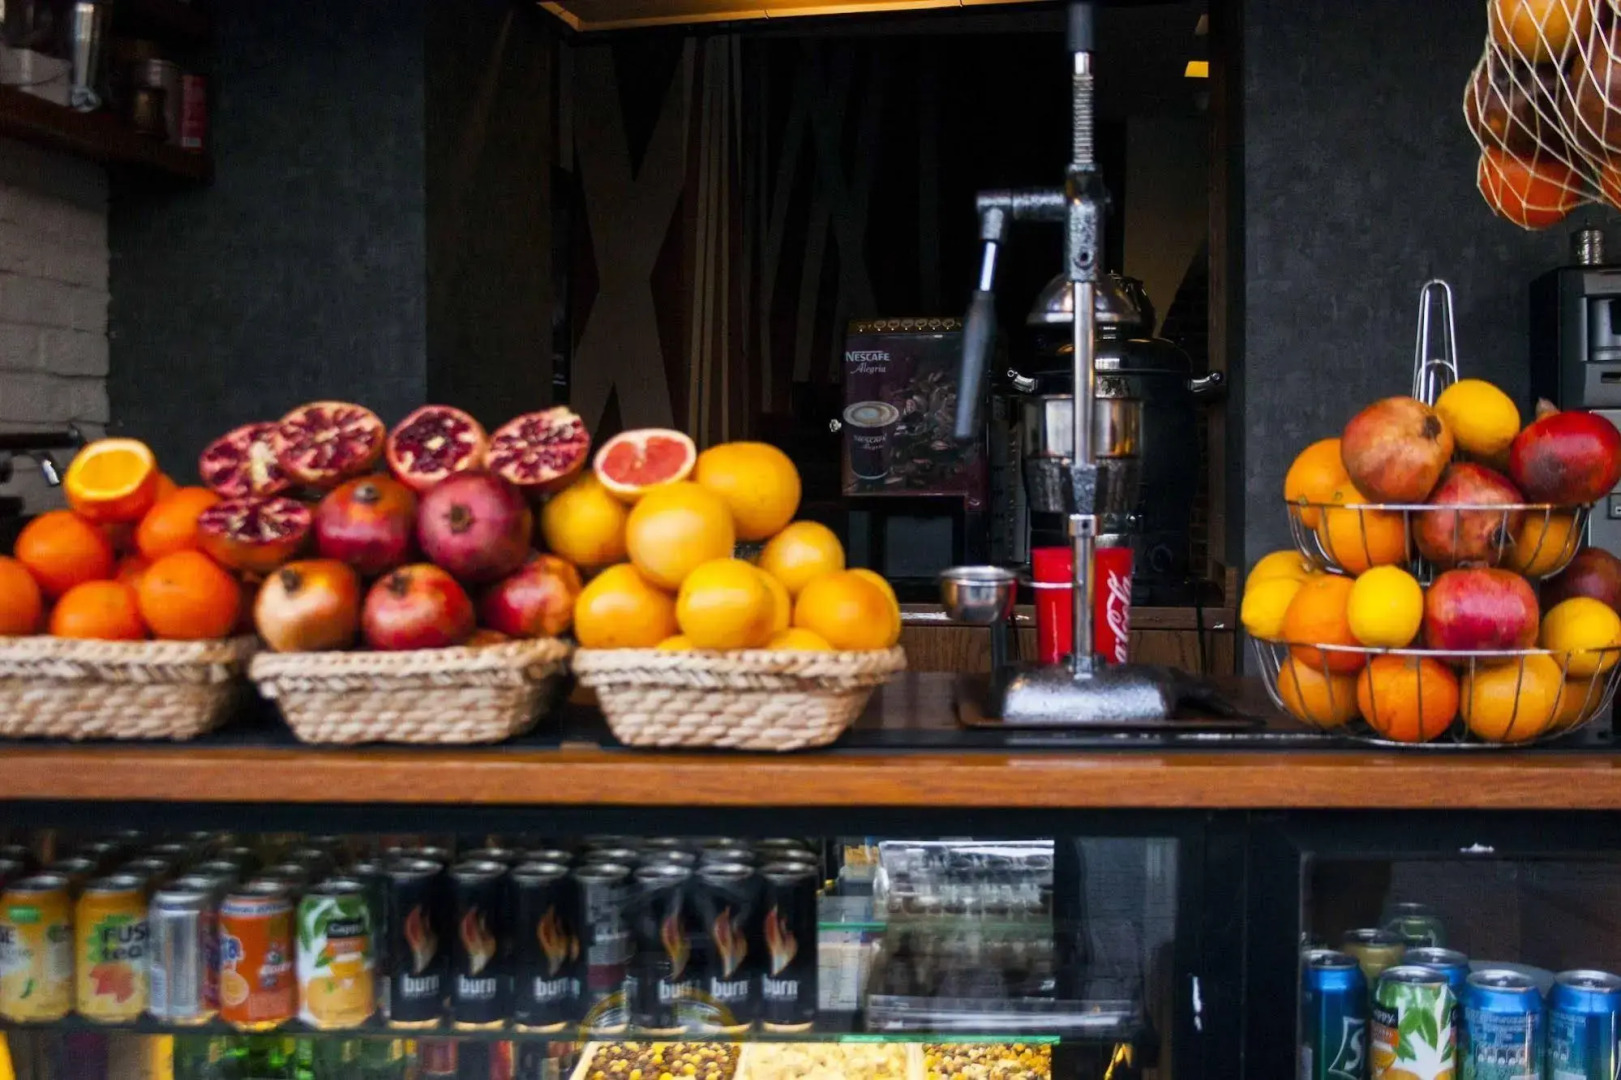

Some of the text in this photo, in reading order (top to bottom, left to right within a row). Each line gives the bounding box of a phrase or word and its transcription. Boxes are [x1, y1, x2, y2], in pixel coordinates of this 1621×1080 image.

[402, 973, 440, 993] burn
[459, 974, 497, 994] burn
[710, 976, 749, 997] burn
[762, 974, 799, 995] burn
